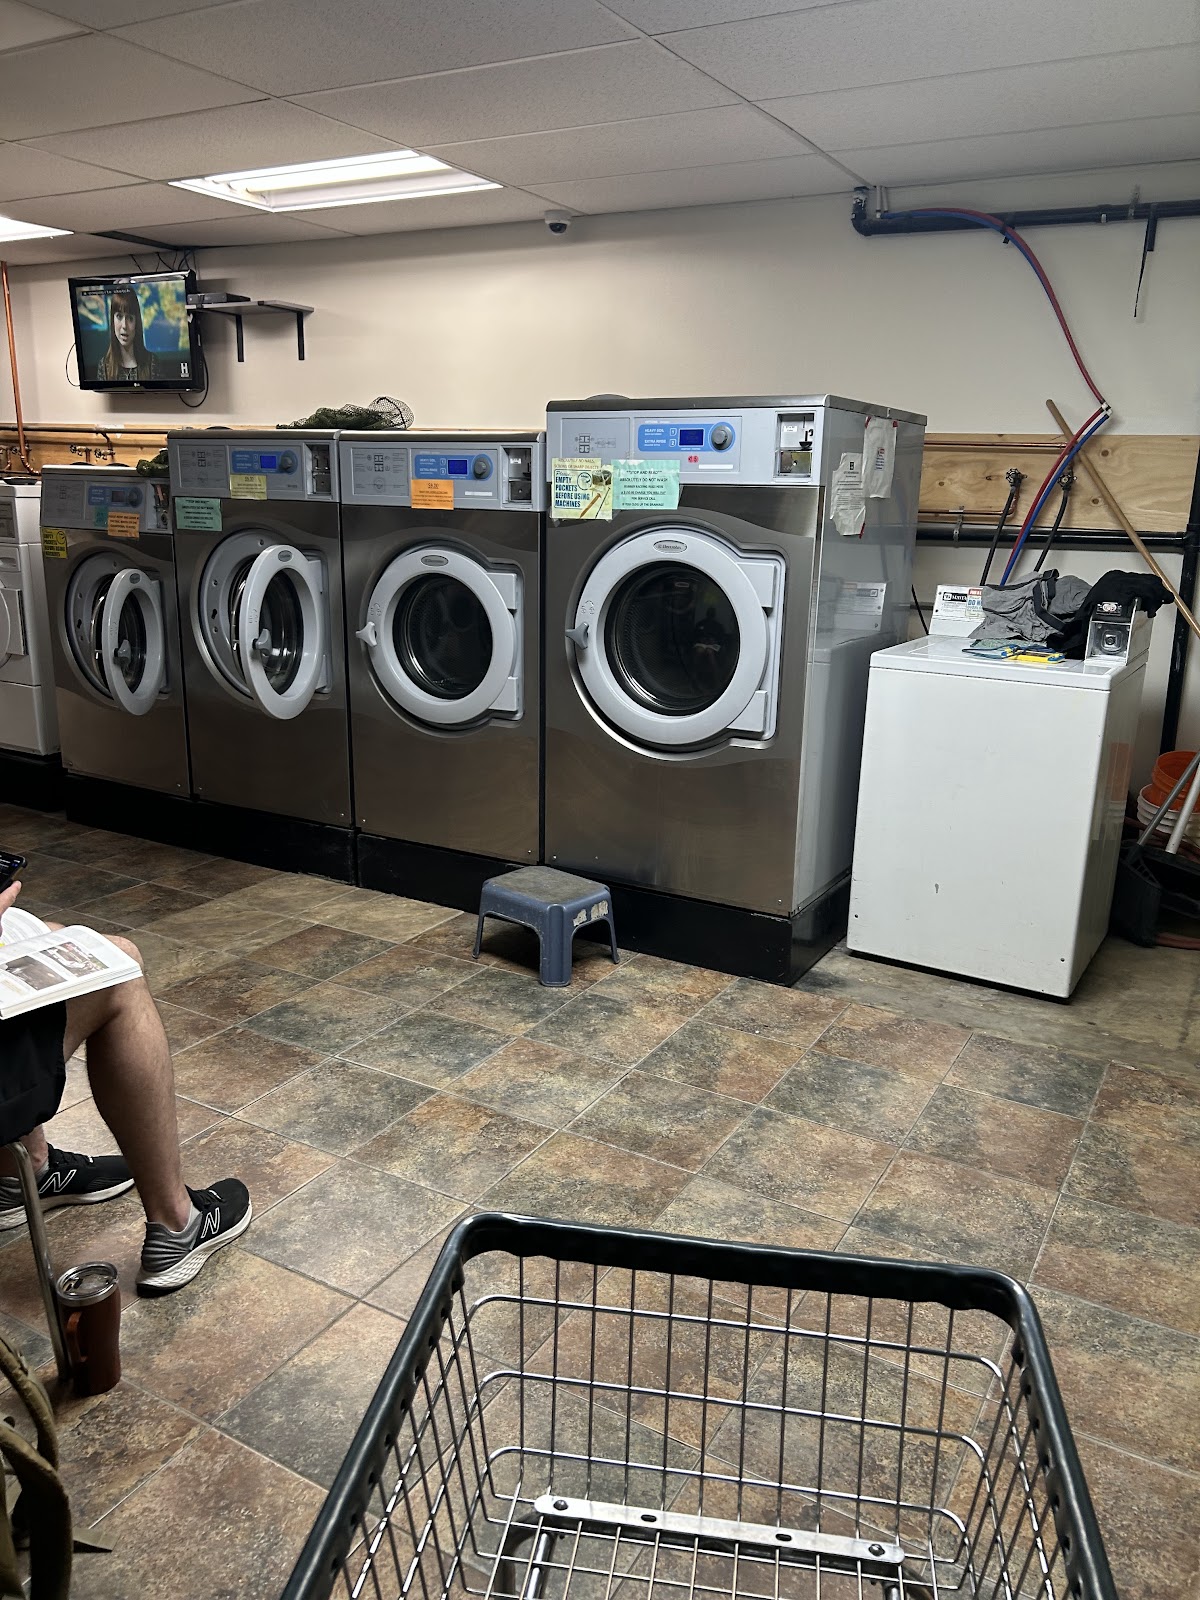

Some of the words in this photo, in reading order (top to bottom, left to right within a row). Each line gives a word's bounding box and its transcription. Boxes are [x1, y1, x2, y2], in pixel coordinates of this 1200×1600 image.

[180, 362, 189, 374] H
[555, 476, 572, 484] EMPTY
[555, 484, 578, 492] POCKETS
[555, 492, 574, 500] BEFORE
[574, 493, 590, 501] USING
[554, 499, 581, 508] MACHINES
[39, 1169, 77, 1193] N
[200, 1207, 220, 1238] N
